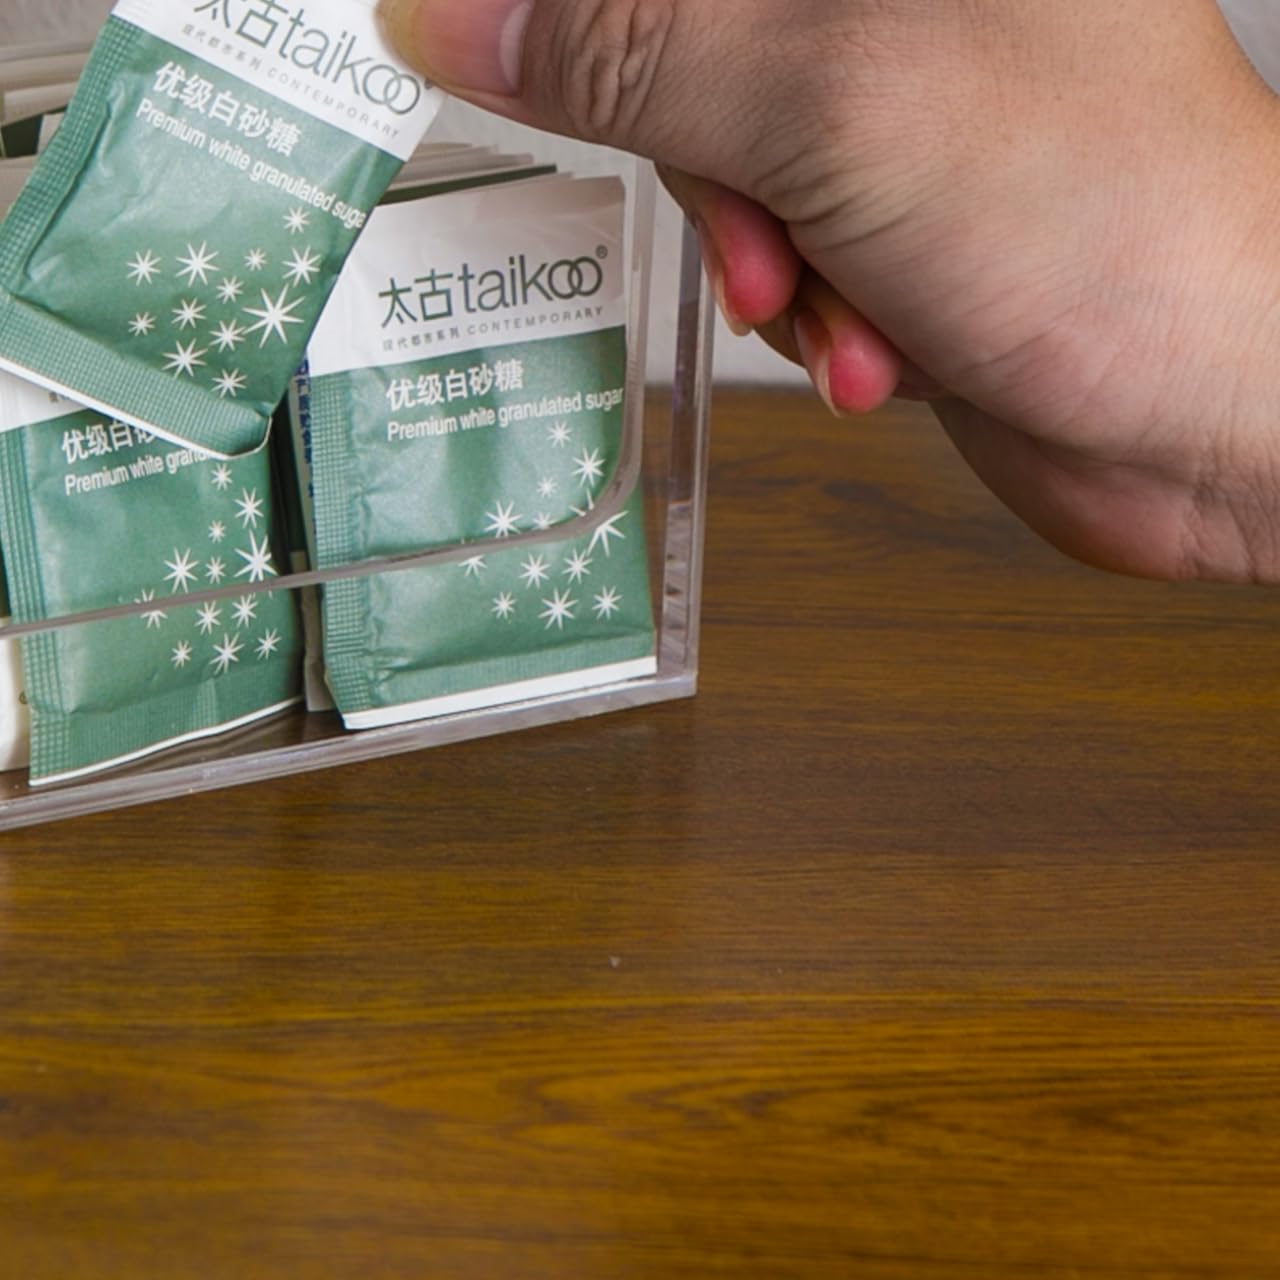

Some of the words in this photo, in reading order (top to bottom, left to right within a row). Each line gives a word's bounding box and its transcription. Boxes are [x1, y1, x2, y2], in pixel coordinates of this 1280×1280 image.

[152, 61, 302, 158] 优级白砂糖
[267, 68, 401, 139] CONTEMPORARY
[135, 98, 207, 149] Premium
[208, 139, 250, 171] white
[249, 160, 336, 211] granulated
[331, 202, 367, 229] suga
[467, 305, 604, 336] CONTEMPORARY
[386, 358, 524, 411] 优级白砂糖
[387, 415, 458, 442] Premium
[459, 407, 495, 430] white
[498, 391, 582, 425] granulated
[584, 387, 624, 411] sugar
[64, 464, 130, 496] Premium
[130, 454, 164, 480] white
